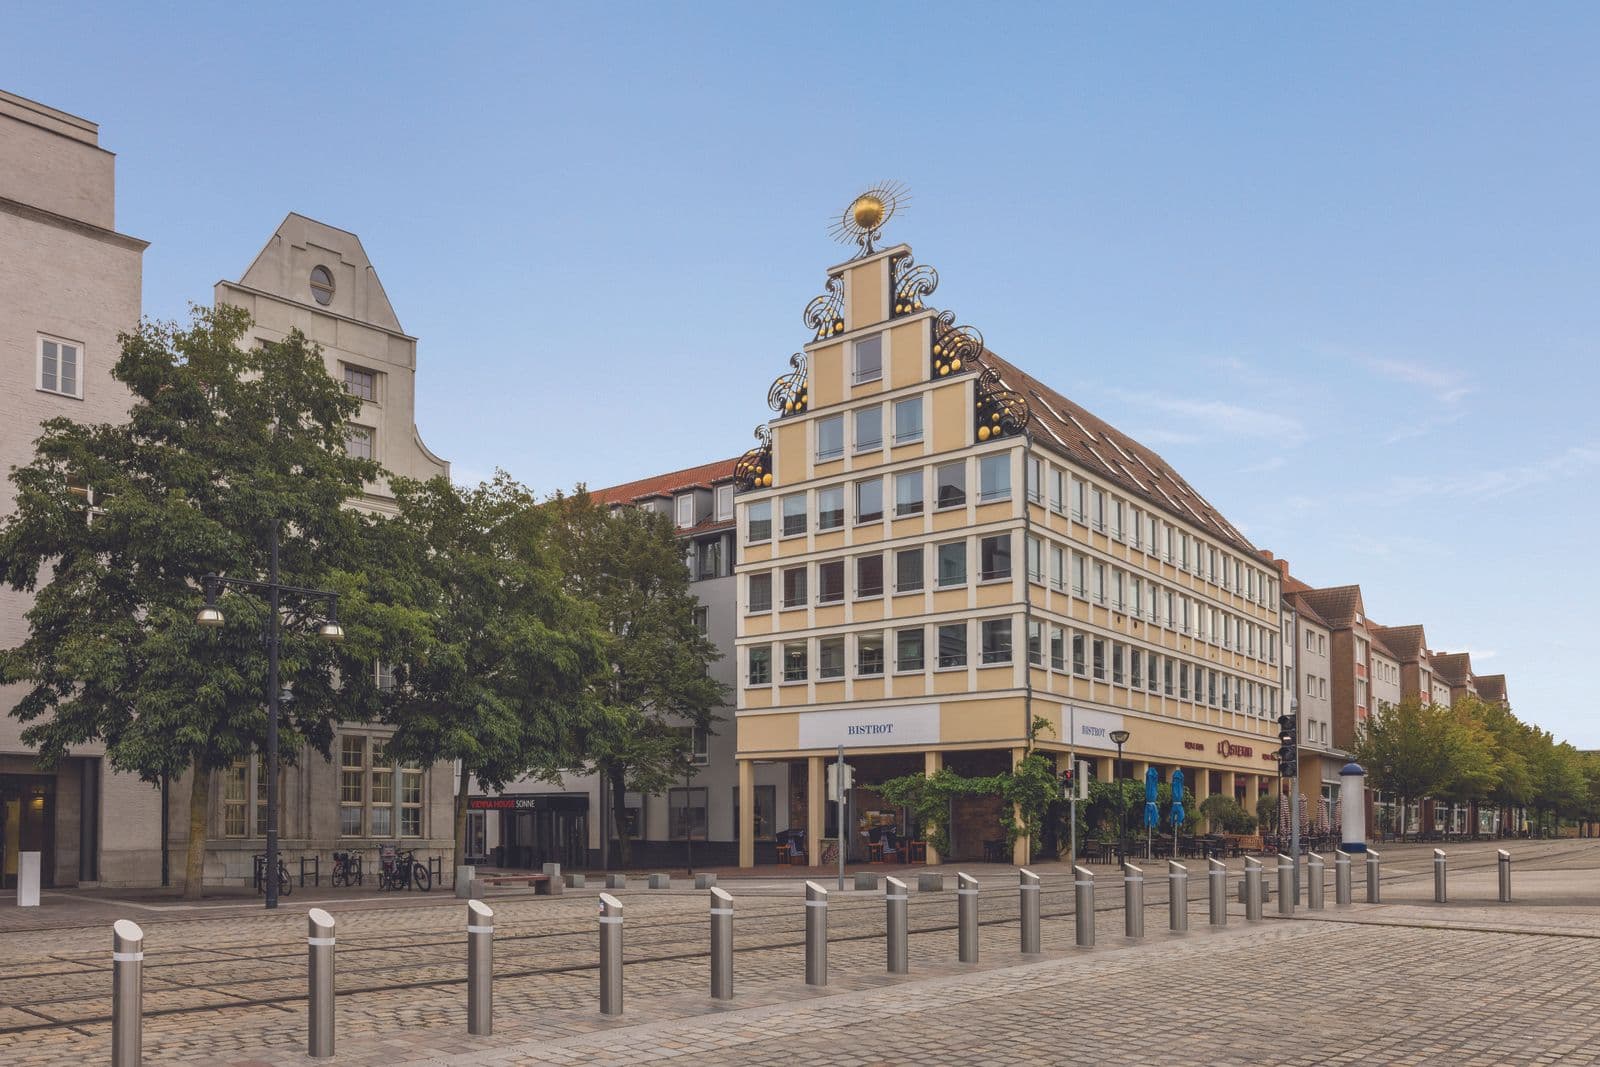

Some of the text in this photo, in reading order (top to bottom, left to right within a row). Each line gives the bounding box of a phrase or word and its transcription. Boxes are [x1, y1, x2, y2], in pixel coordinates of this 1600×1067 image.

[848, 724, 893, 735] BISTROT
[1082, 725, 1105, 737] BISTROT
[515, 799, 535, 808] SONNE
